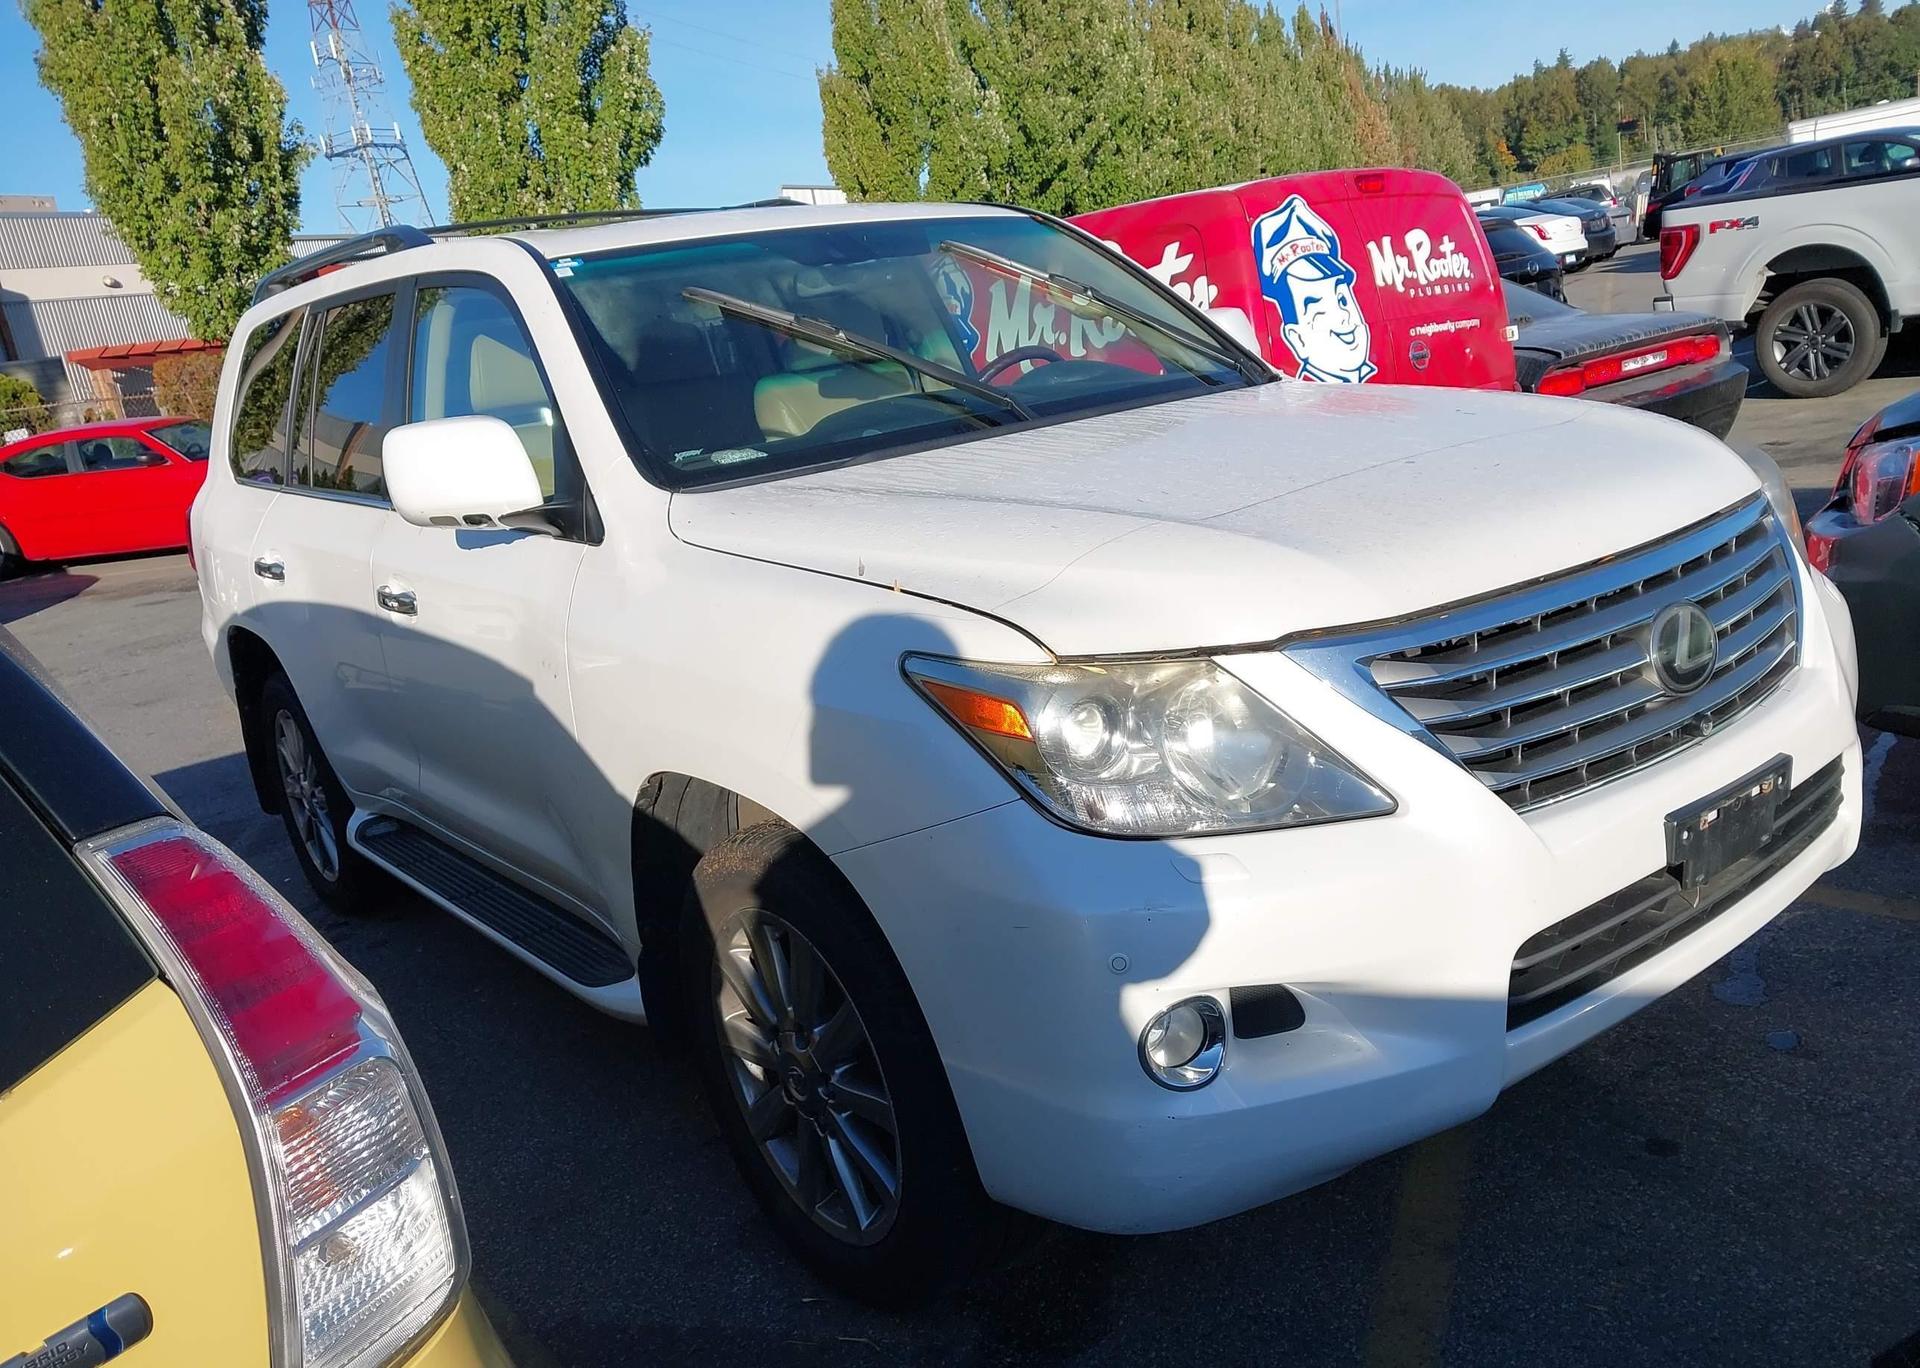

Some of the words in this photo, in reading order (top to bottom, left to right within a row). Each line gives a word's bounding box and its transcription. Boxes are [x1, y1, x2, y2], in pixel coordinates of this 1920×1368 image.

[1709, 216, 1759, 234] FX4
[1366, 236, 1418, 292] Mr.
[1409, 282, 1470, 298] PLUMBING
[1416, 320, 1455, 336] neighbourly
[1455, 319, 1480, 330] company
[22, 1342, 69, 1368] BRID
